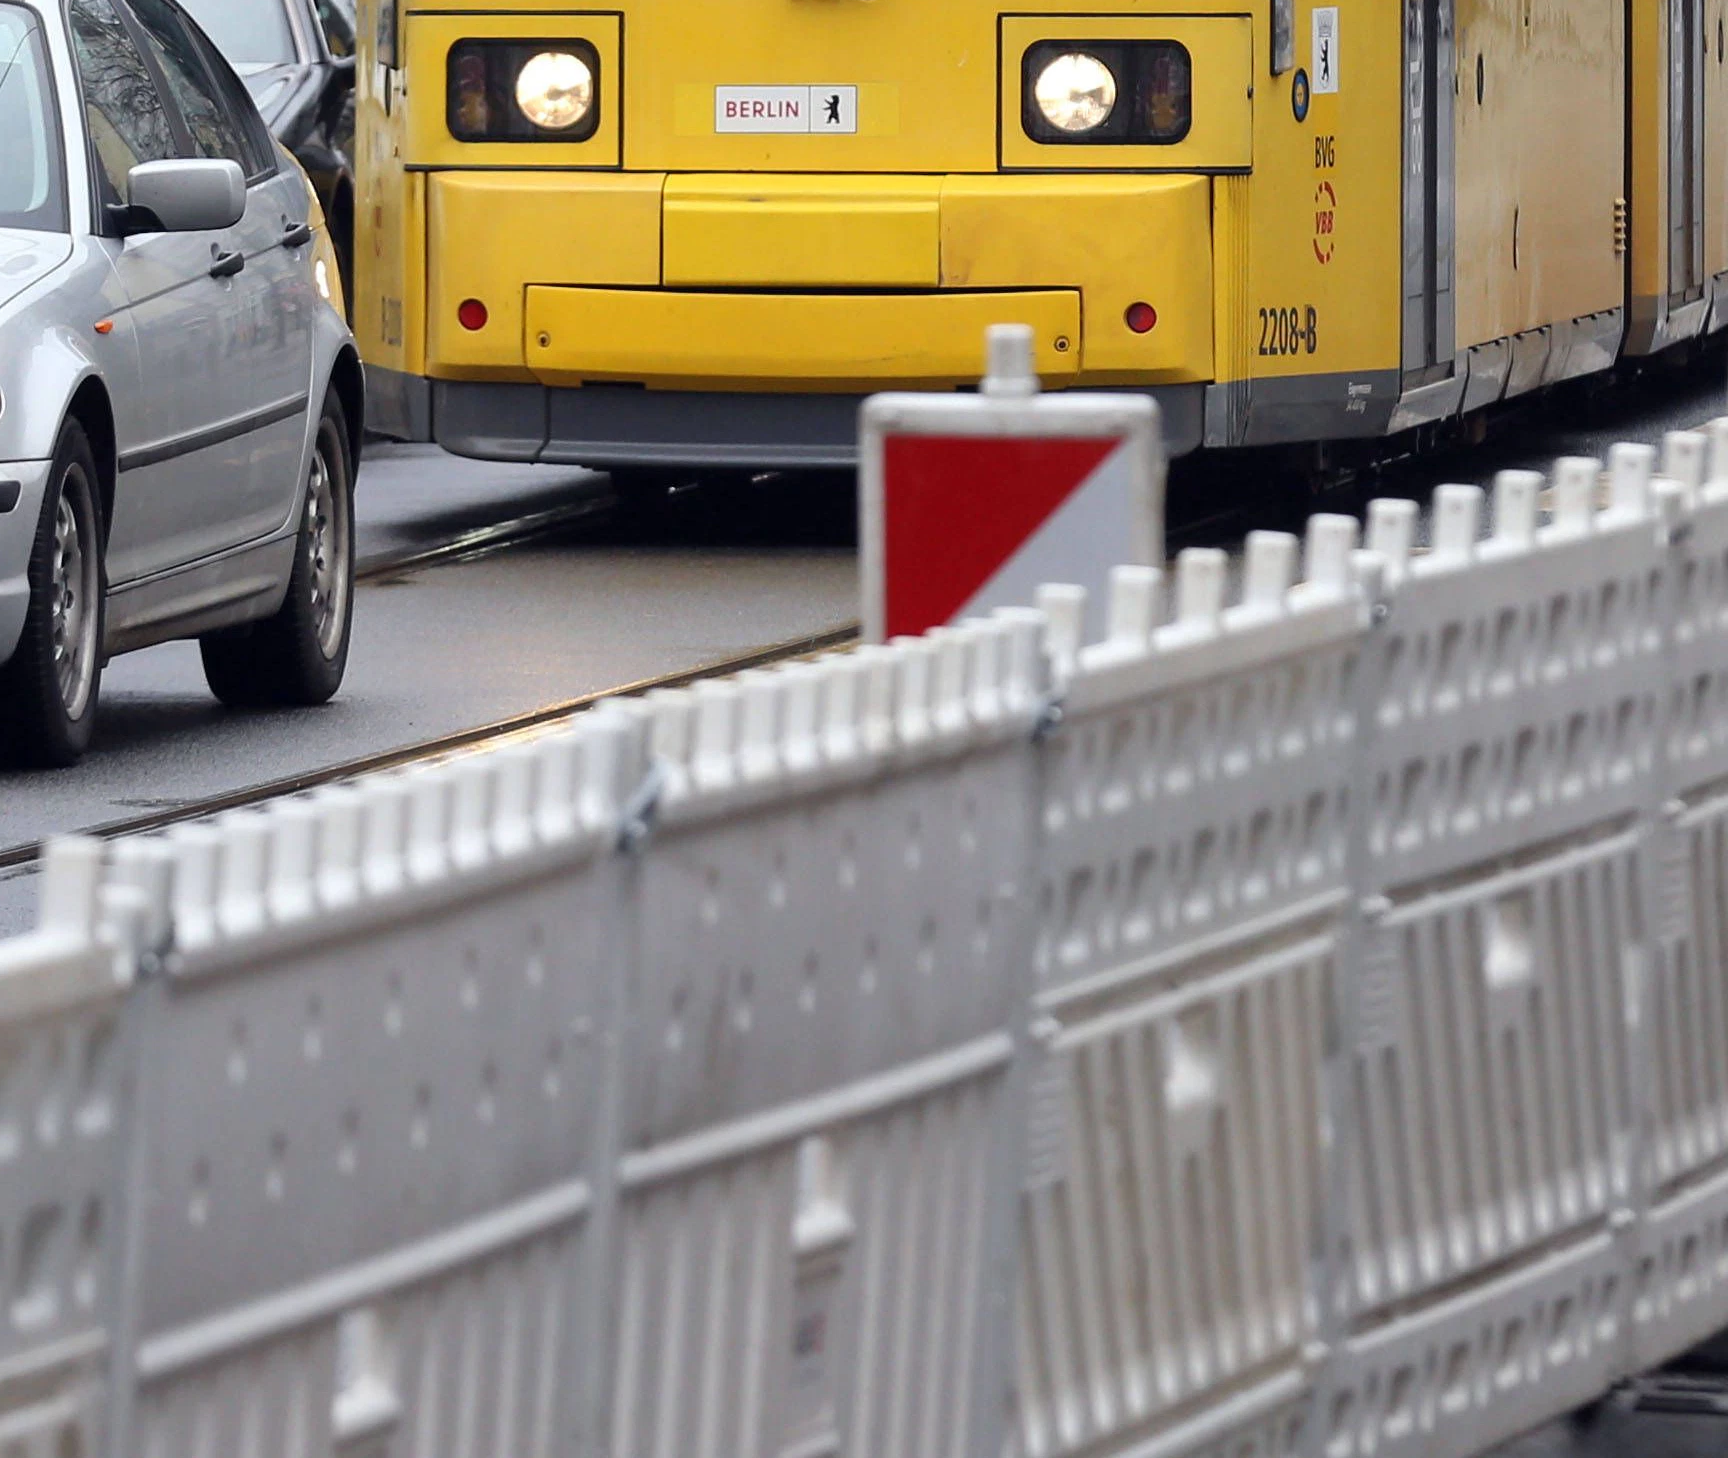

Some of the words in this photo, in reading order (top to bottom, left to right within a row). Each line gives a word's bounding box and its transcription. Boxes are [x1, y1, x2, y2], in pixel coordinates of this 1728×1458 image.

[725, 100, 799, 118] BERLIN
[1315, 136, 1335, 168] BVG
[1315, 210, 1334, 235] VBB
[1258, 305, 1318, 356] 2208-B
